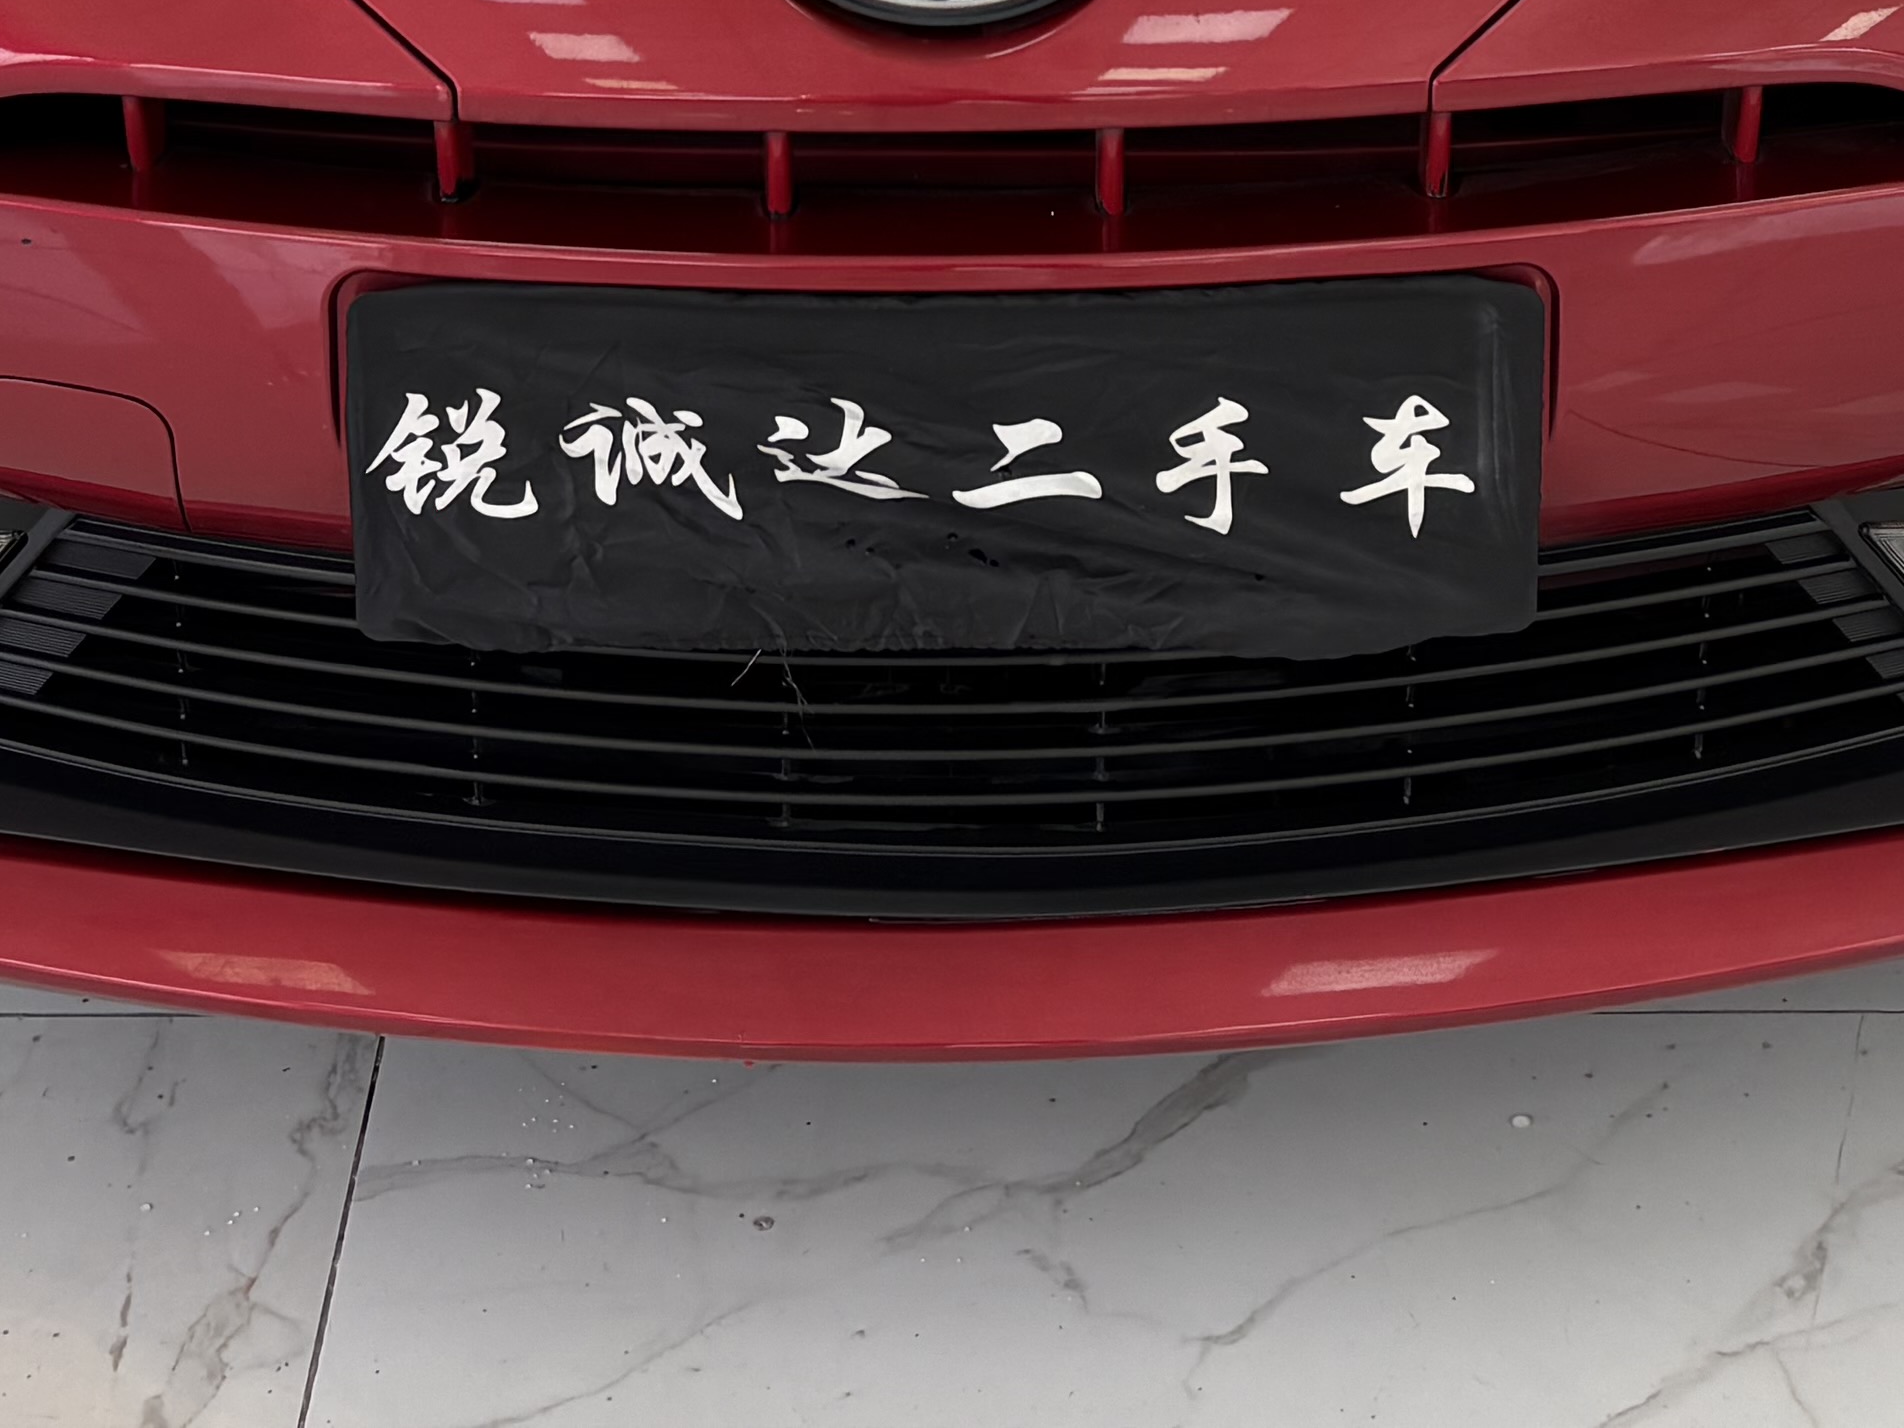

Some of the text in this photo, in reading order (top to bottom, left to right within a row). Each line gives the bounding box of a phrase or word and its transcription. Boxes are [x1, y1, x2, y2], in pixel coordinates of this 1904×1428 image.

[366, 387, 1475, 539] 锐诚达二手车
